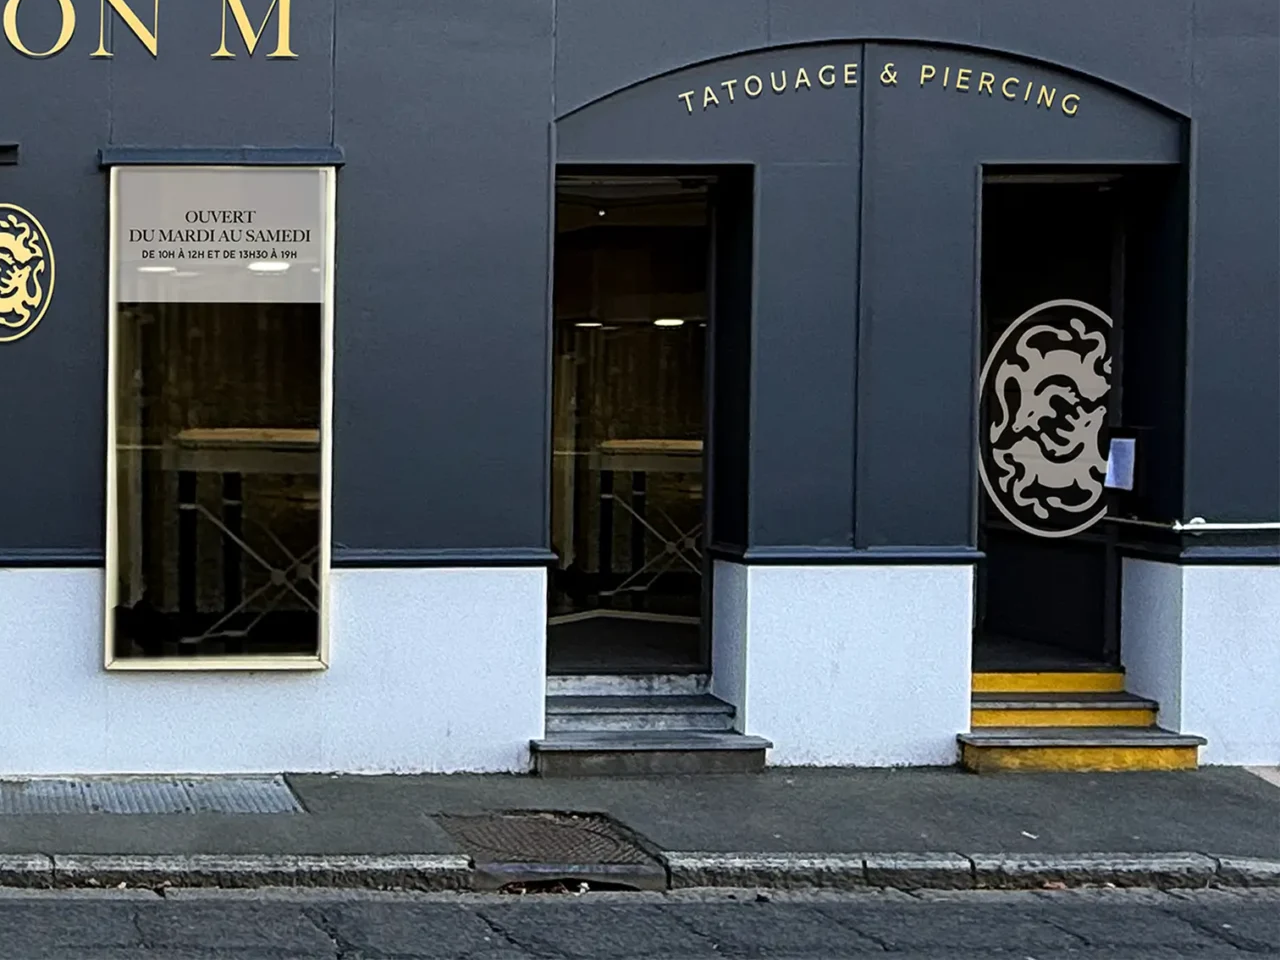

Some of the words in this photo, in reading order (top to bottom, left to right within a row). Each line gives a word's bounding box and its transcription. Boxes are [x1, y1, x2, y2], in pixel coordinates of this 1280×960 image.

[677, 62, 858, 114] TATOUAGE
[879, 62, 898, 86] &
[920, 63, 1082, 116] PIERCING
[185, 210, 256, 224] OUVERT
[129, 229, 155, 243] DU
[158, 229, 215, 243] MARDI
[218, 229, 242, 243] AU
[245, 229, 311, 243] SAMEDI
[142, 250, 155, 259] DE
[158, 250, 175, 259] 10H
[177, 247, 185, 259] À
[188, 250, 205, 259] 12H
[207, 250, 221, 259] ET
[223, 250, 236, 259] DE
[239, 250, 269, 259] 13H30
[270, 247, 278, 259] À
[281, 250, 298, 259] 19H
